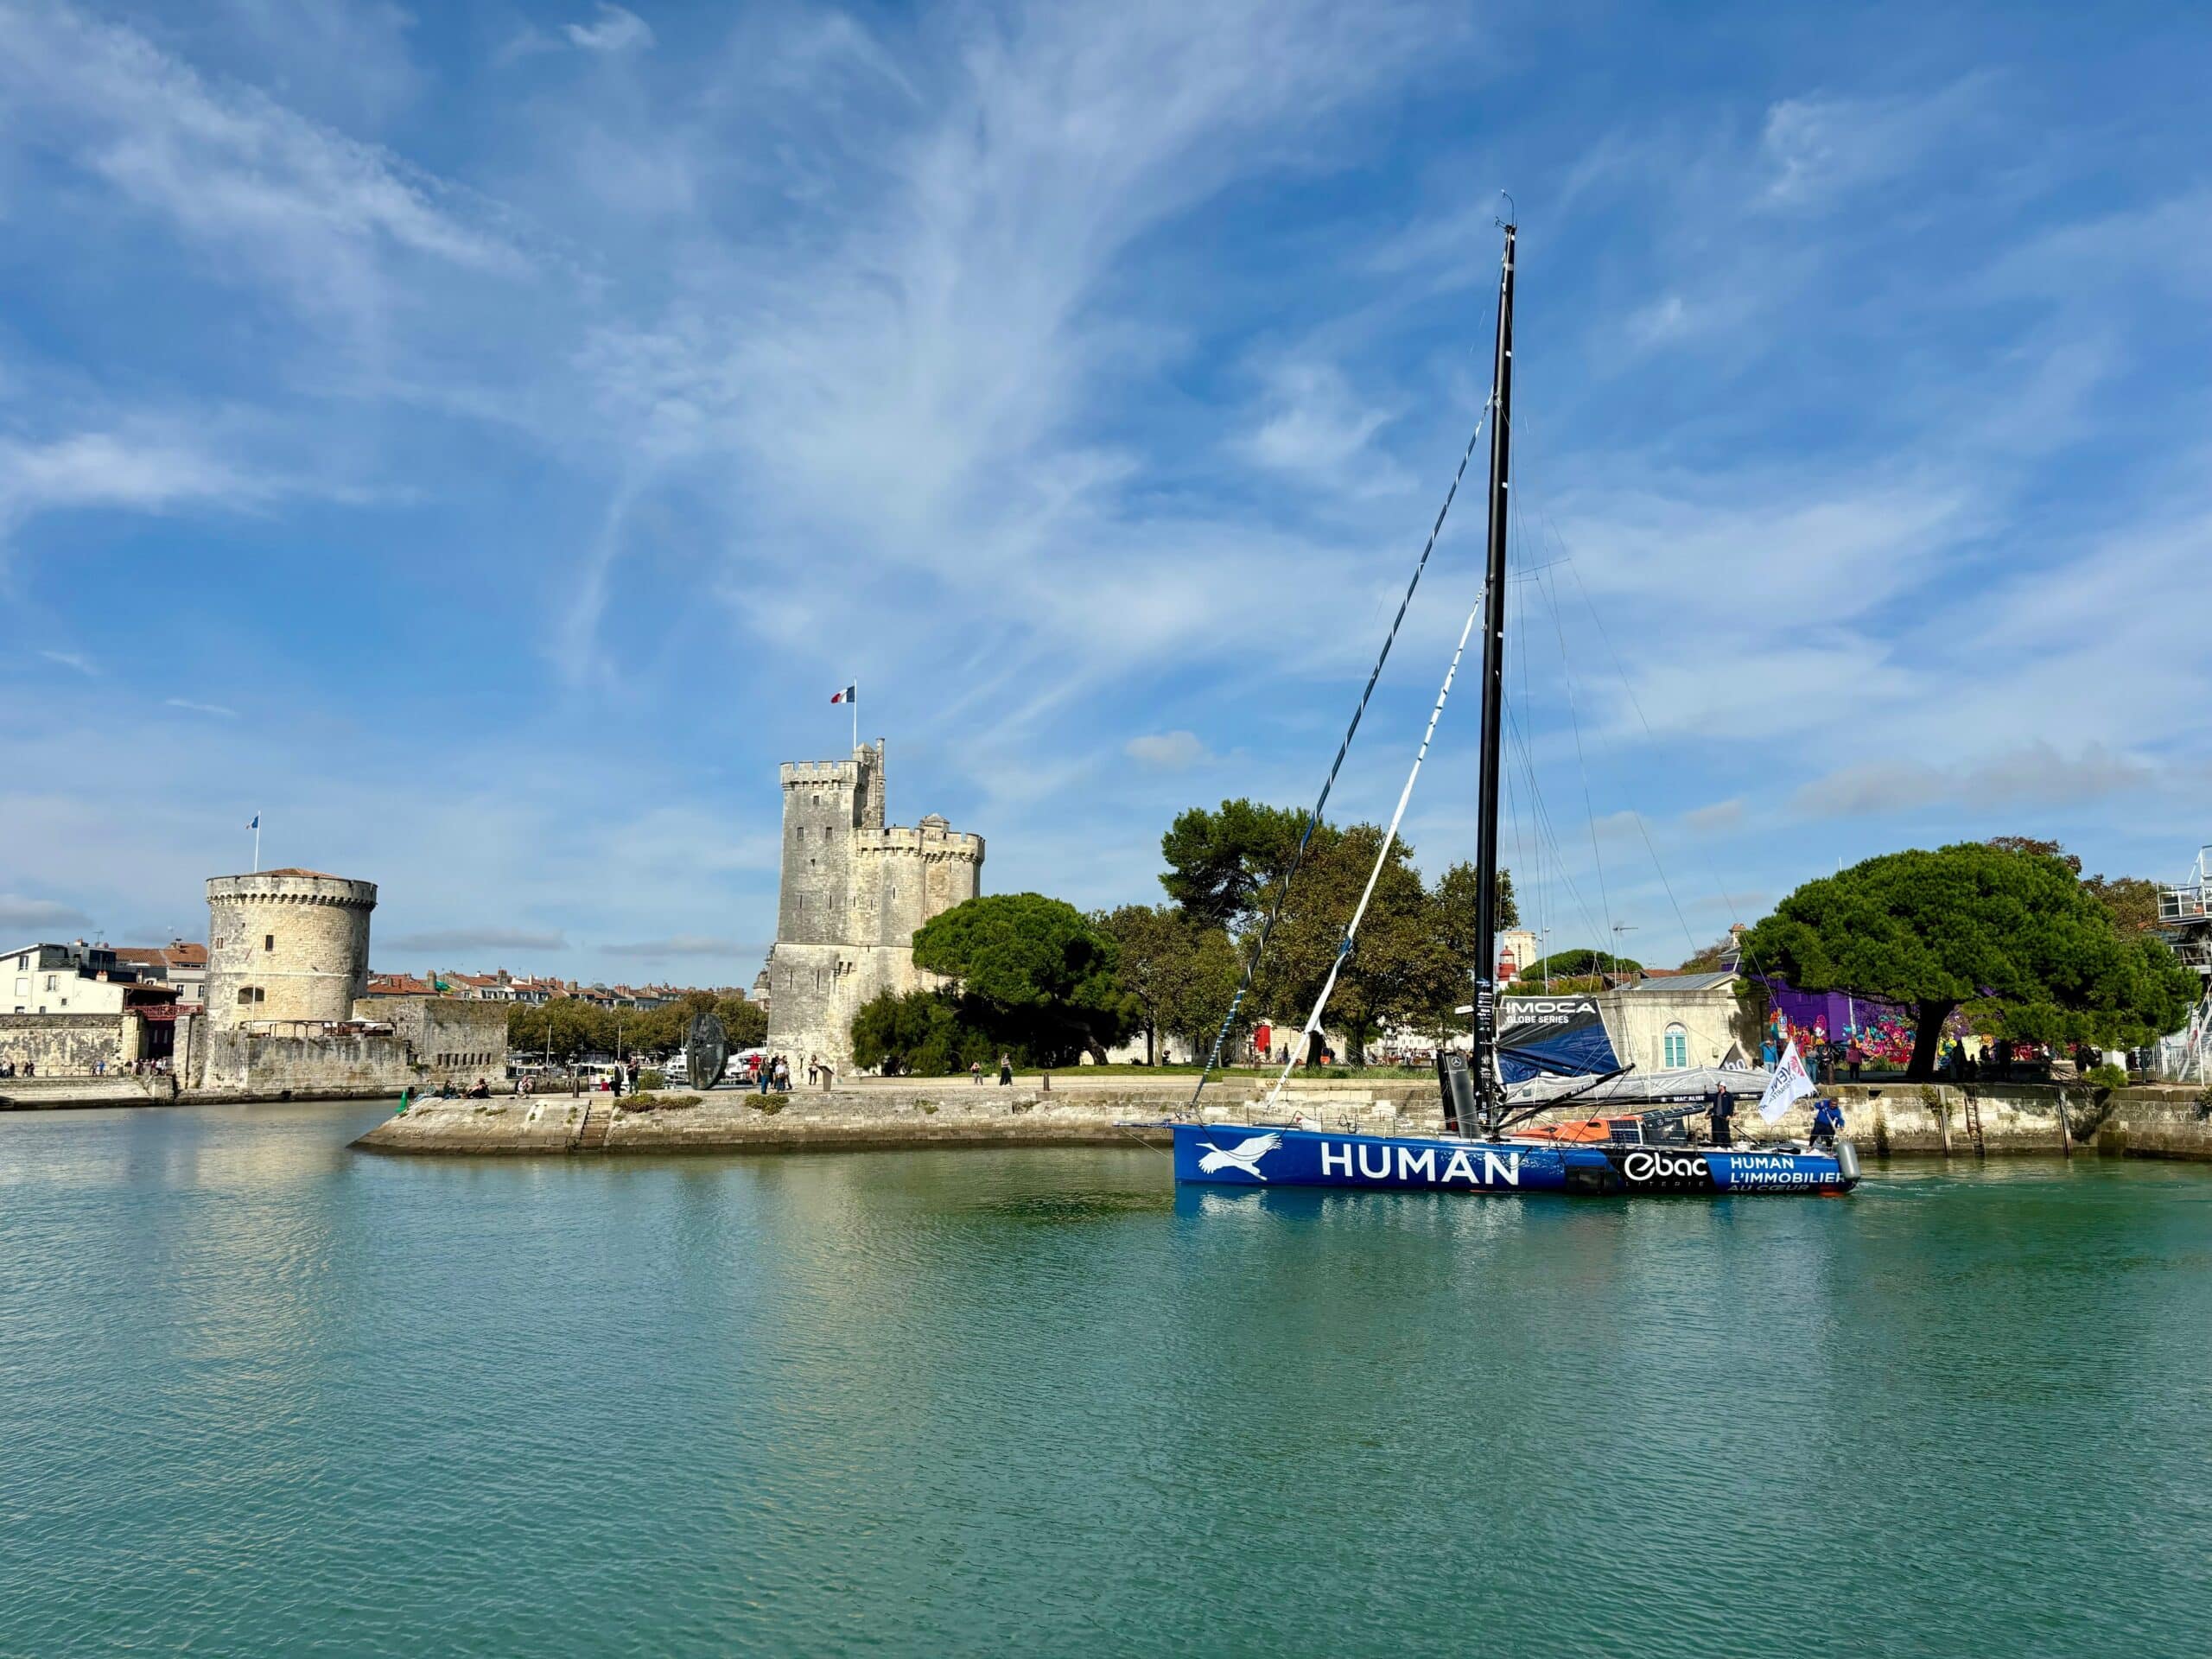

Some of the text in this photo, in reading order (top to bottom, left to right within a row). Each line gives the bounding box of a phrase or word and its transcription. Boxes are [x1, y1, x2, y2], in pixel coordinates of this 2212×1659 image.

[1506, 1002, 1596, 1014] IMOCA
[1507, 1015, 1569, 1024] GLOBE SERIES
[1320, 1141, 1519, 1185] HUMAN
[1624, 1153, 1707, 1181] ebac
[1731, 1157, 1795, 1169] HUMAN
